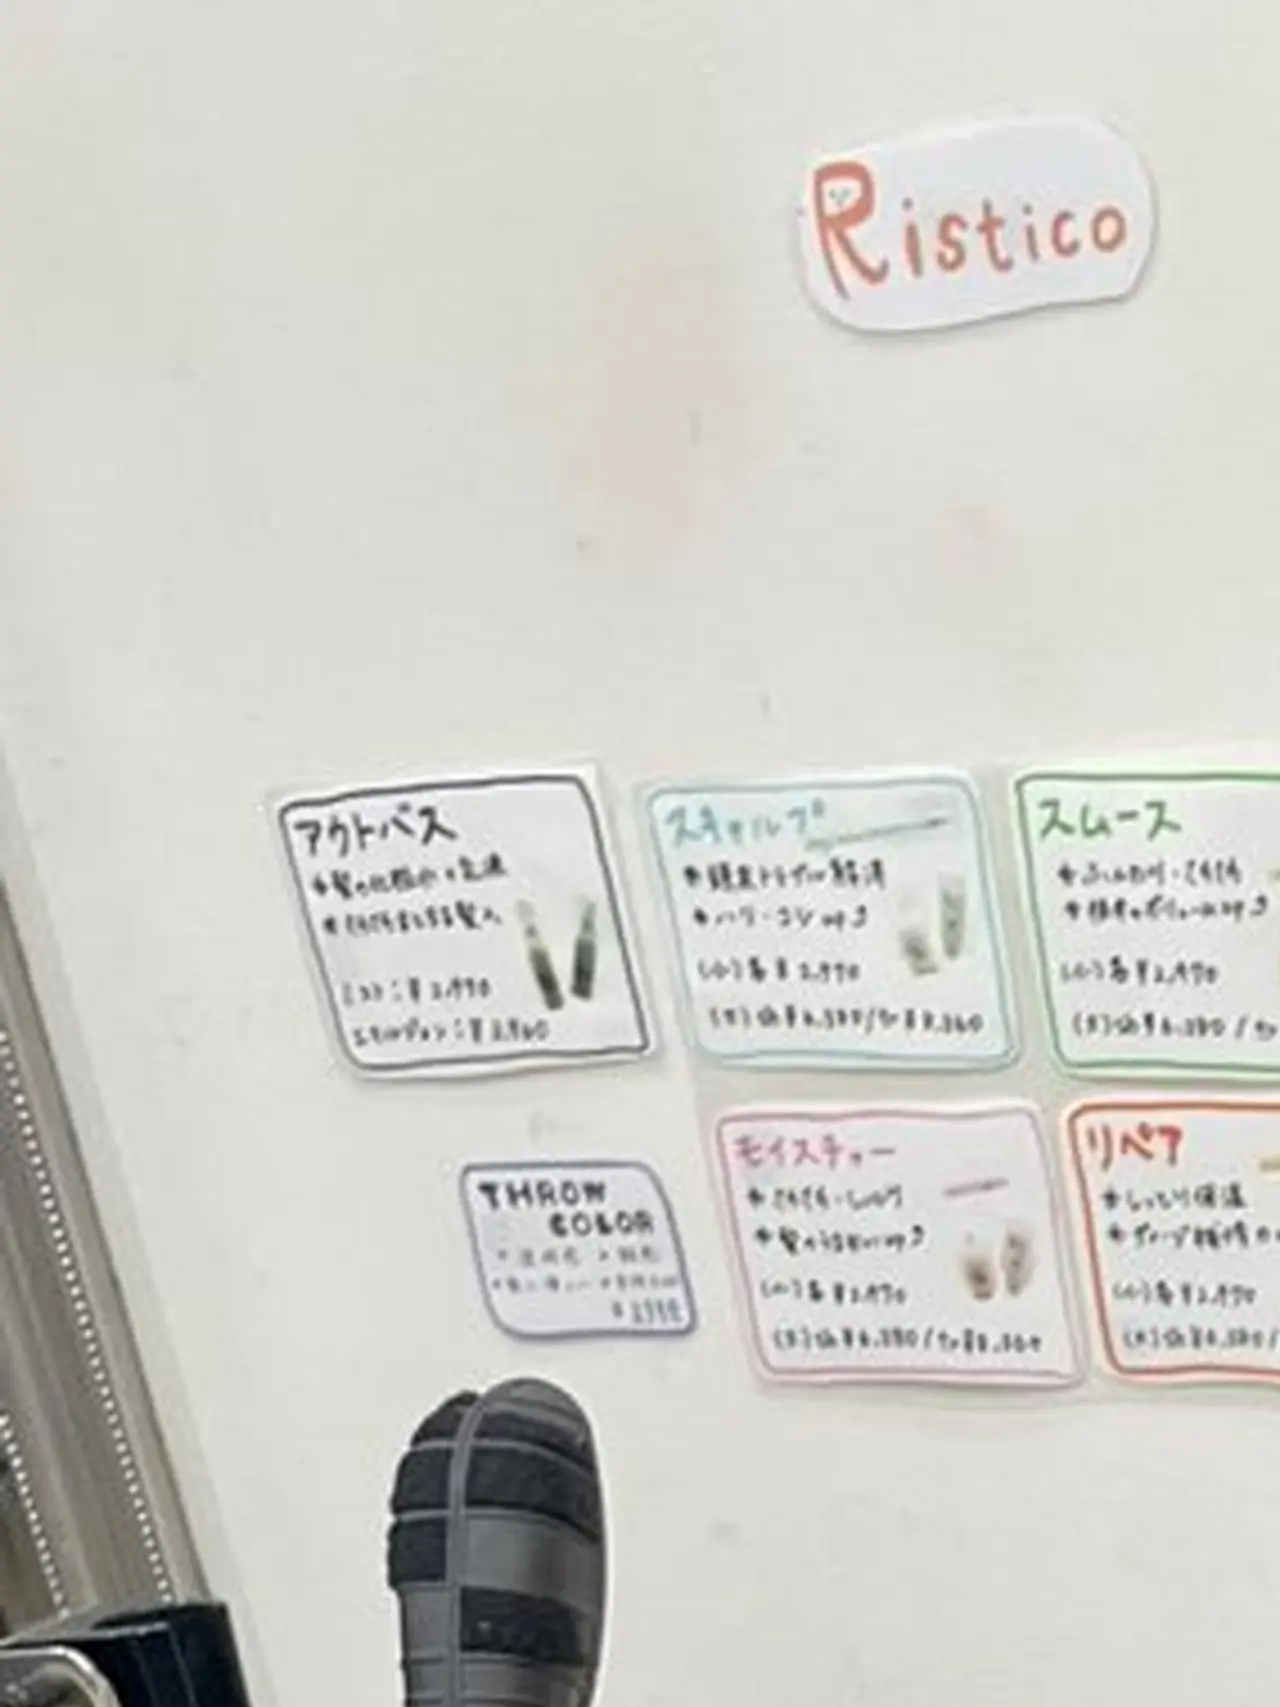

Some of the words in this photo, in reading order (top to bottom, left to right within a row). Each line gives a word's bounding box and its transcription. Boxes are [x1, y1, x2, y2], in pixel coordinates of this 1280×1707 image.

[813, 161, 1128, 300] Ristico
[294, 803, 458, 857] アウトバス
[1038, 798, 1182, 841] スムース
[1086, 1122, 1184, 1172] リペア
[549, 1209, 654, 1237] COLOR
